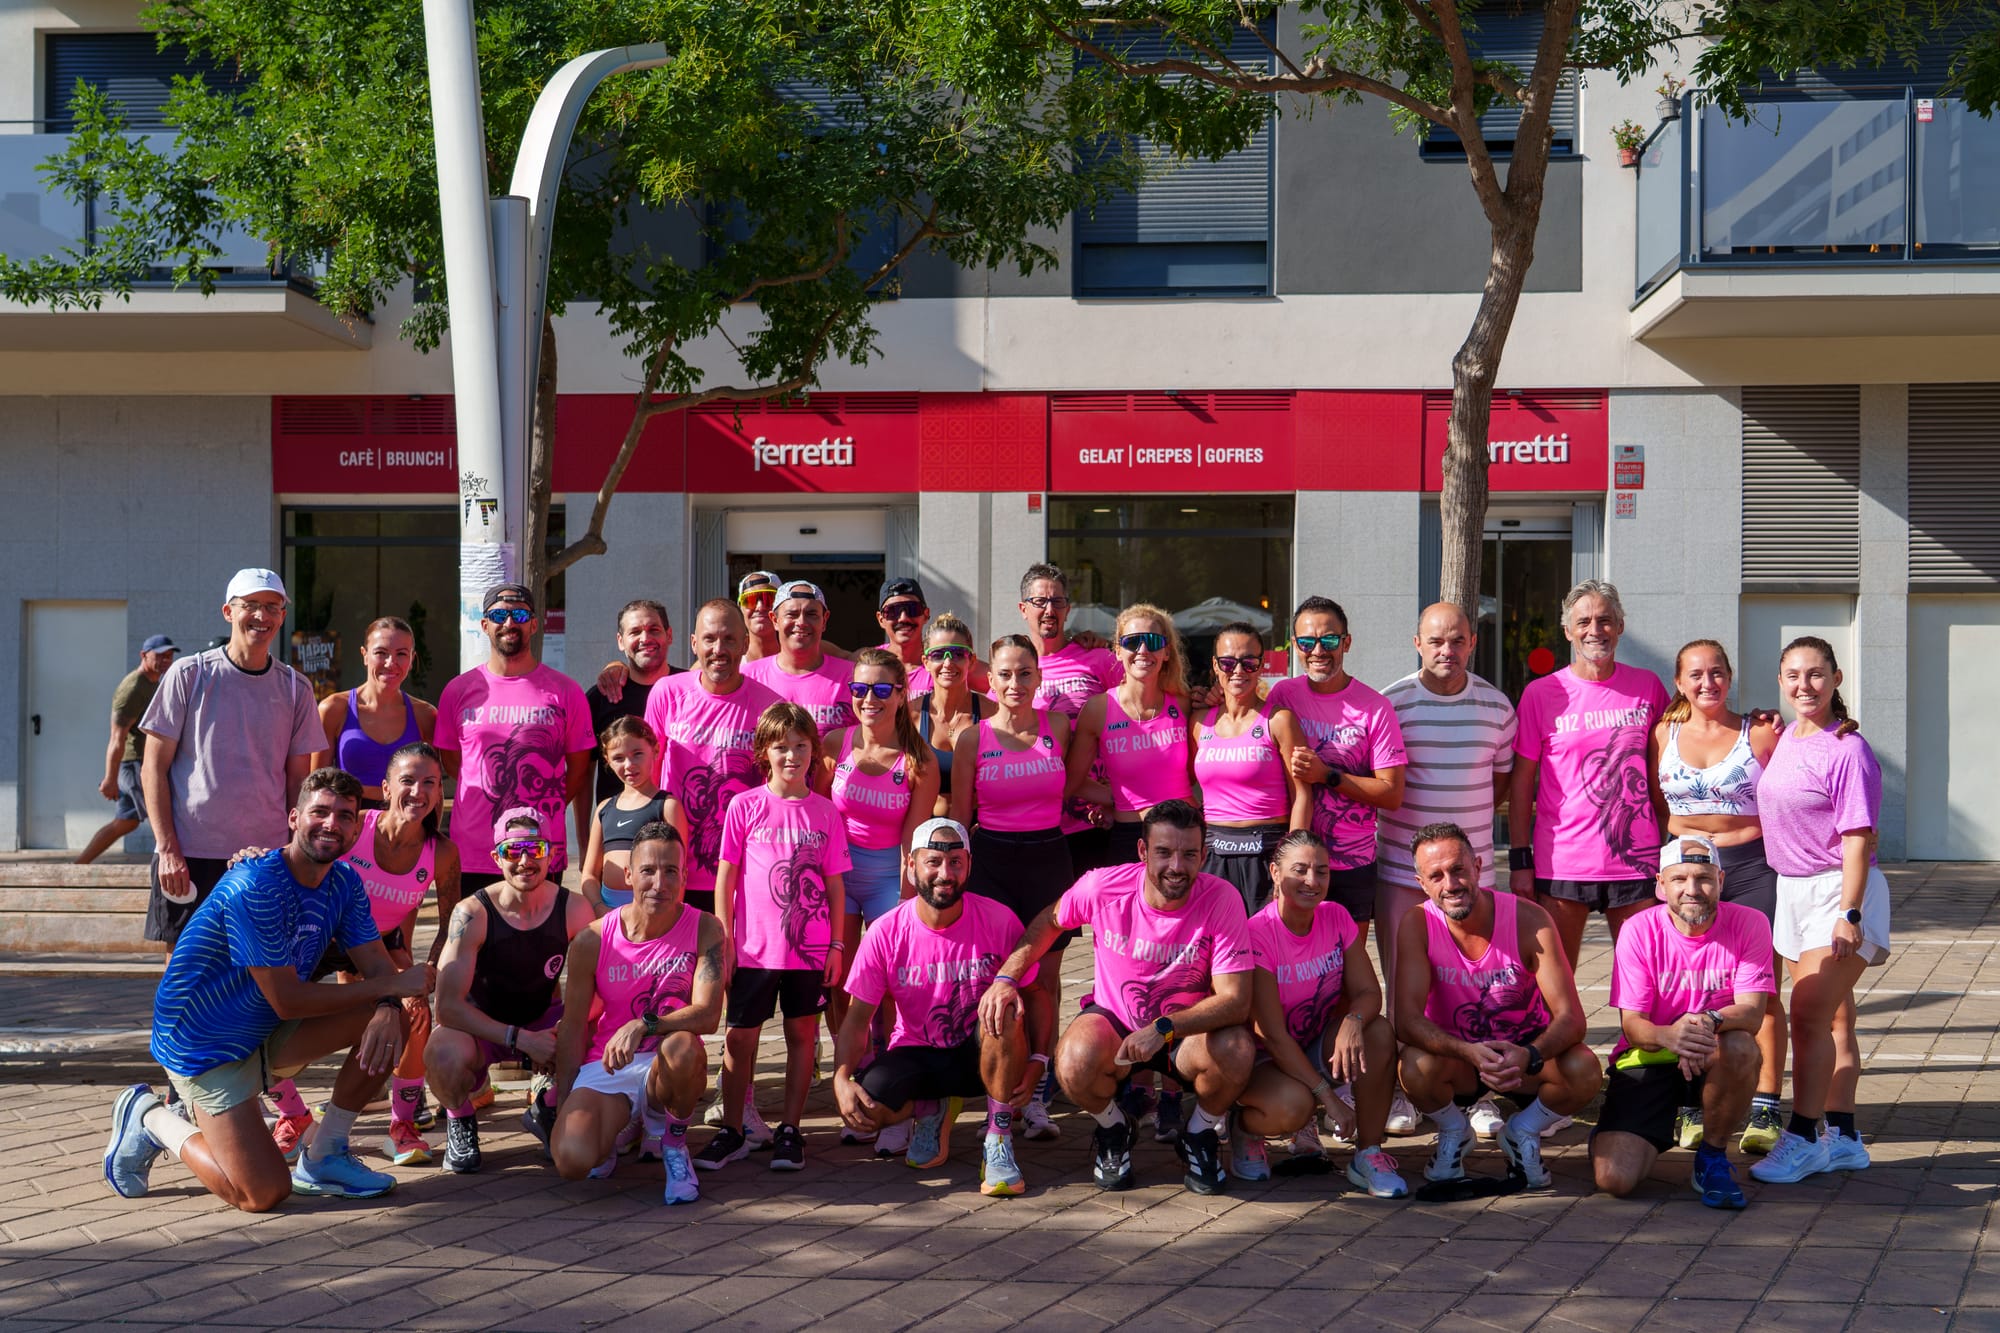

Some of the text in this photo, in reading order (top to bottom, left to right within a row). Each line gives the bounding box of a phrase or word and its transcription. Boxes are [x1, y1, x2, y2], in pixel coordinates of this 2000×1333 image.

[339, 448, 444, 466] CAFÈ BRUNCH
[752, 436, 853, 471] ferretti
[1079, 448, 1263, 464] GELAT CREPES GOFRES
[1487, 433, 1567, 462] rretti
[297, 642, 335, 661] HAPPY
[462, 705, 556, 726] 912 RUNNERS
[1555, 707, 1649, 734] 912 RUNNERS
[669, 721, 691, 744] 912
[1106, 736, 1128, 754] 912
[1205, 745, 1273, 763] RUNNERS
[845, 783, 911, 810] RUNNERS
[1239, 840, 1262, 852] MAX
[1103, 928, 1129, 956] 912
[608, 964, 629, 983] 912
[898, 958, 991, 987] 912 RUNNERS
